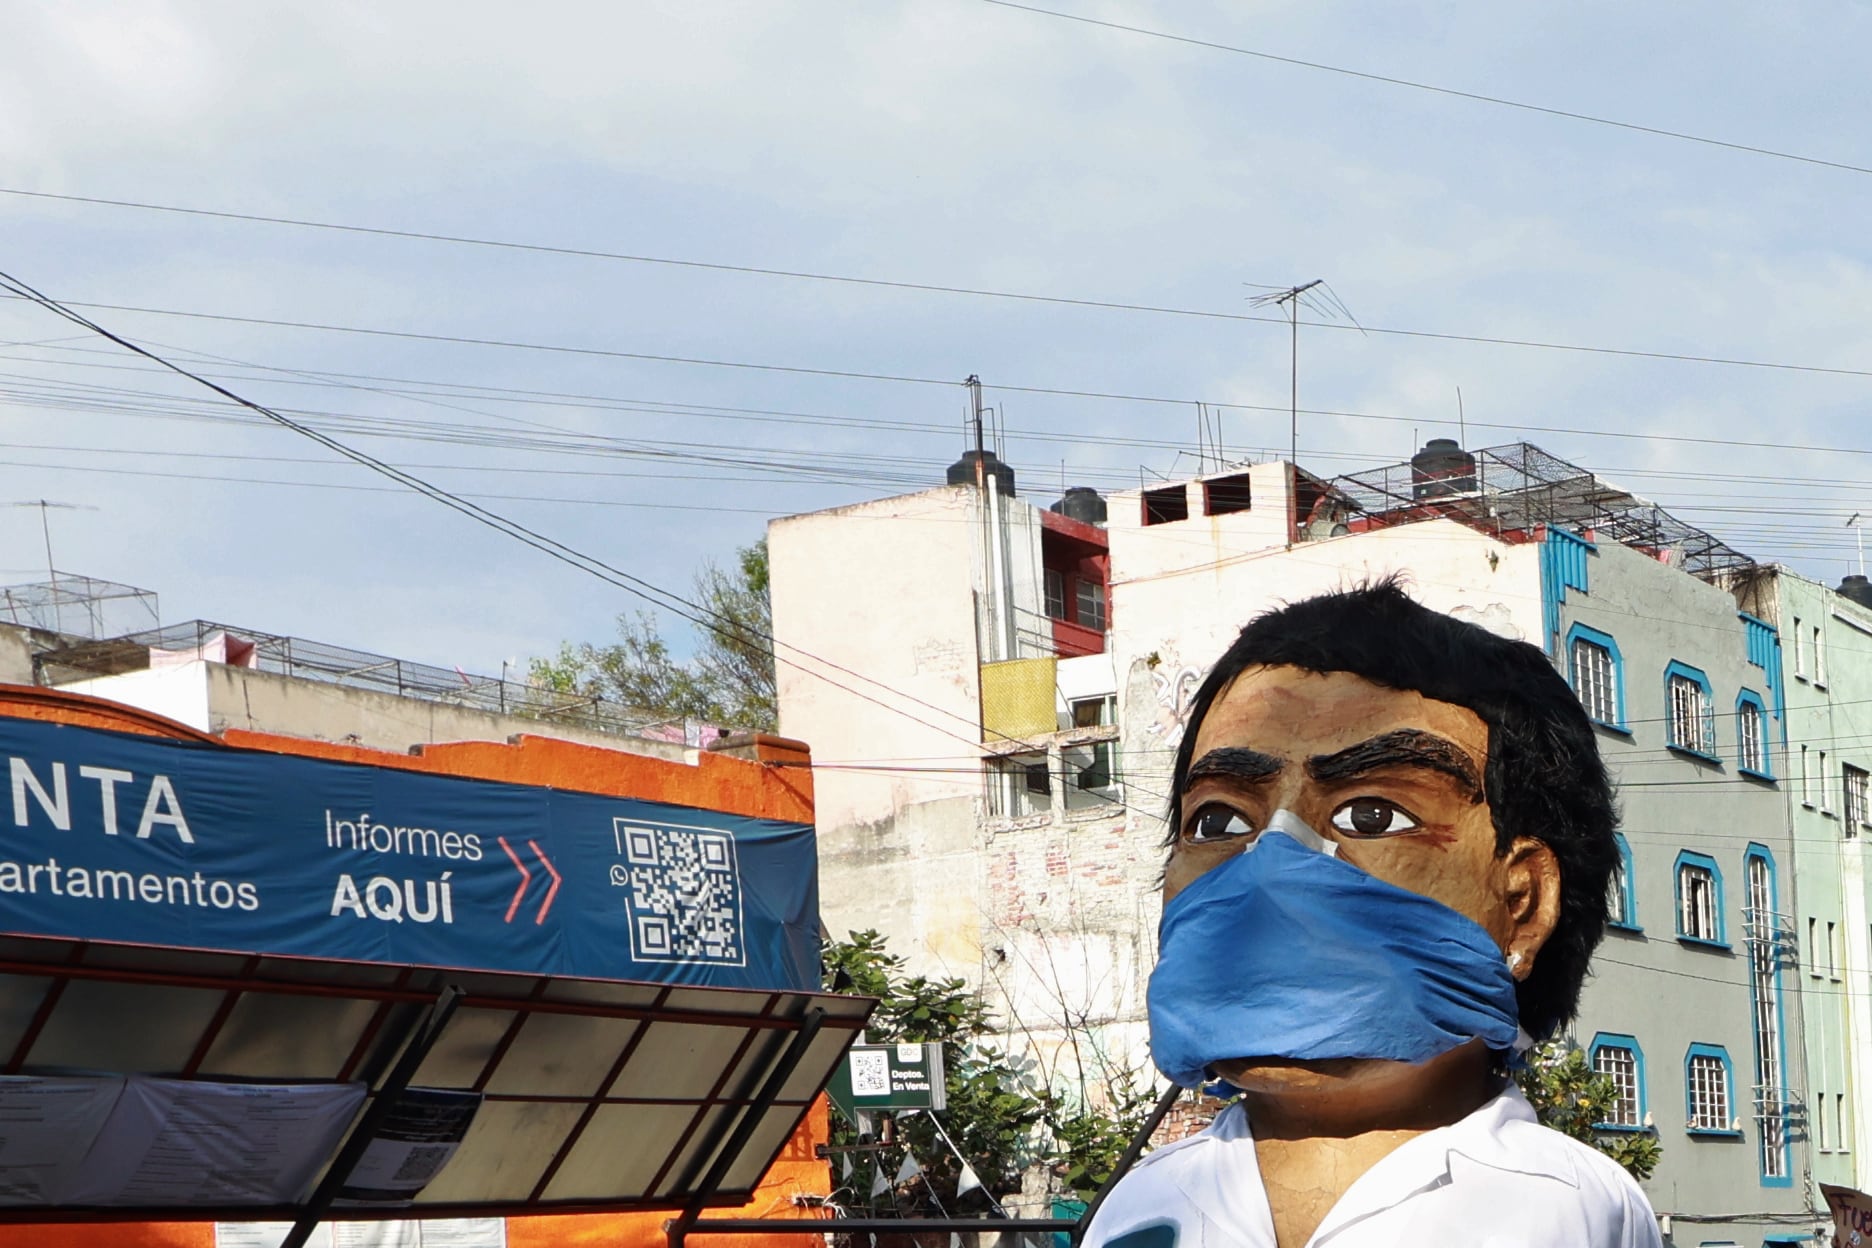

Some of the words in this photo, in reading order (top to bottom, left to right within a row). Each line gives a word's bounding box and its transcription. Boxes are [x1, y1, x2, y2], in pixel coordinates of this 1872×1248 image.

[326, 810, 482, 861] Informes
[330, 871, 454, 924] AQUÍ
[891, 1069, 925, 1080] Deptos.
[893, 1082, 904, 1090] En
[905, 1081, 930, 1090] Venta
